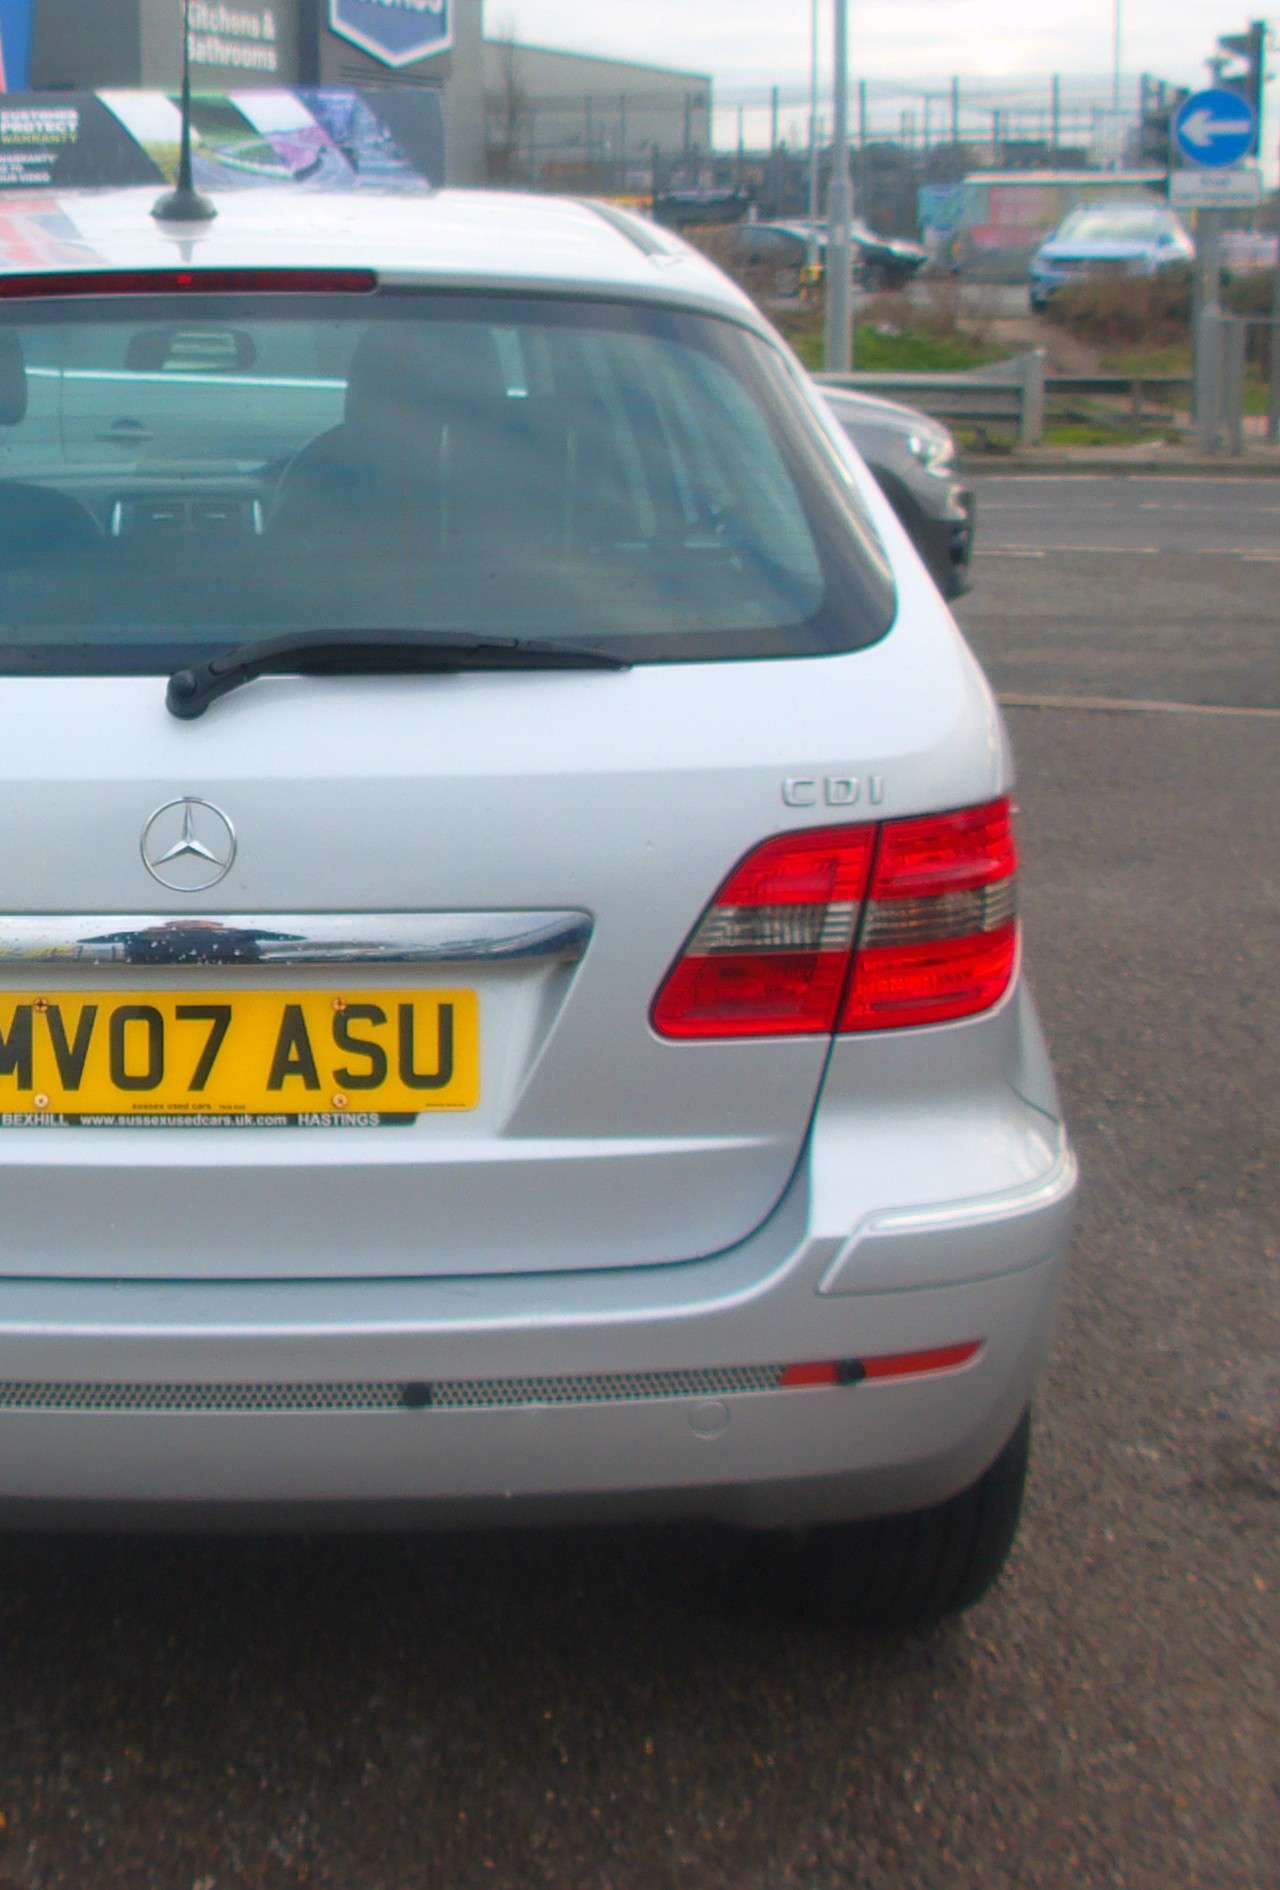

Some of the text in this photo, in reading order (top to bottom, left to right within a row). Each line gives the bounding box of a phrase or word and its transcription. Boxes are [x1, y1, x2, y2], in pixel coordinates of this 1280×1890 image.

[0, 120, 78, 133] PROTECT
[1, 133, 78, 144] WARRANTY
[781, 775, 885, 808] CDI
[266, 1004, 454, 1091] ASU
[1, 1112, 381, 1128] BEXHILL www.sussexusedcars.uk.com HASTINGS
